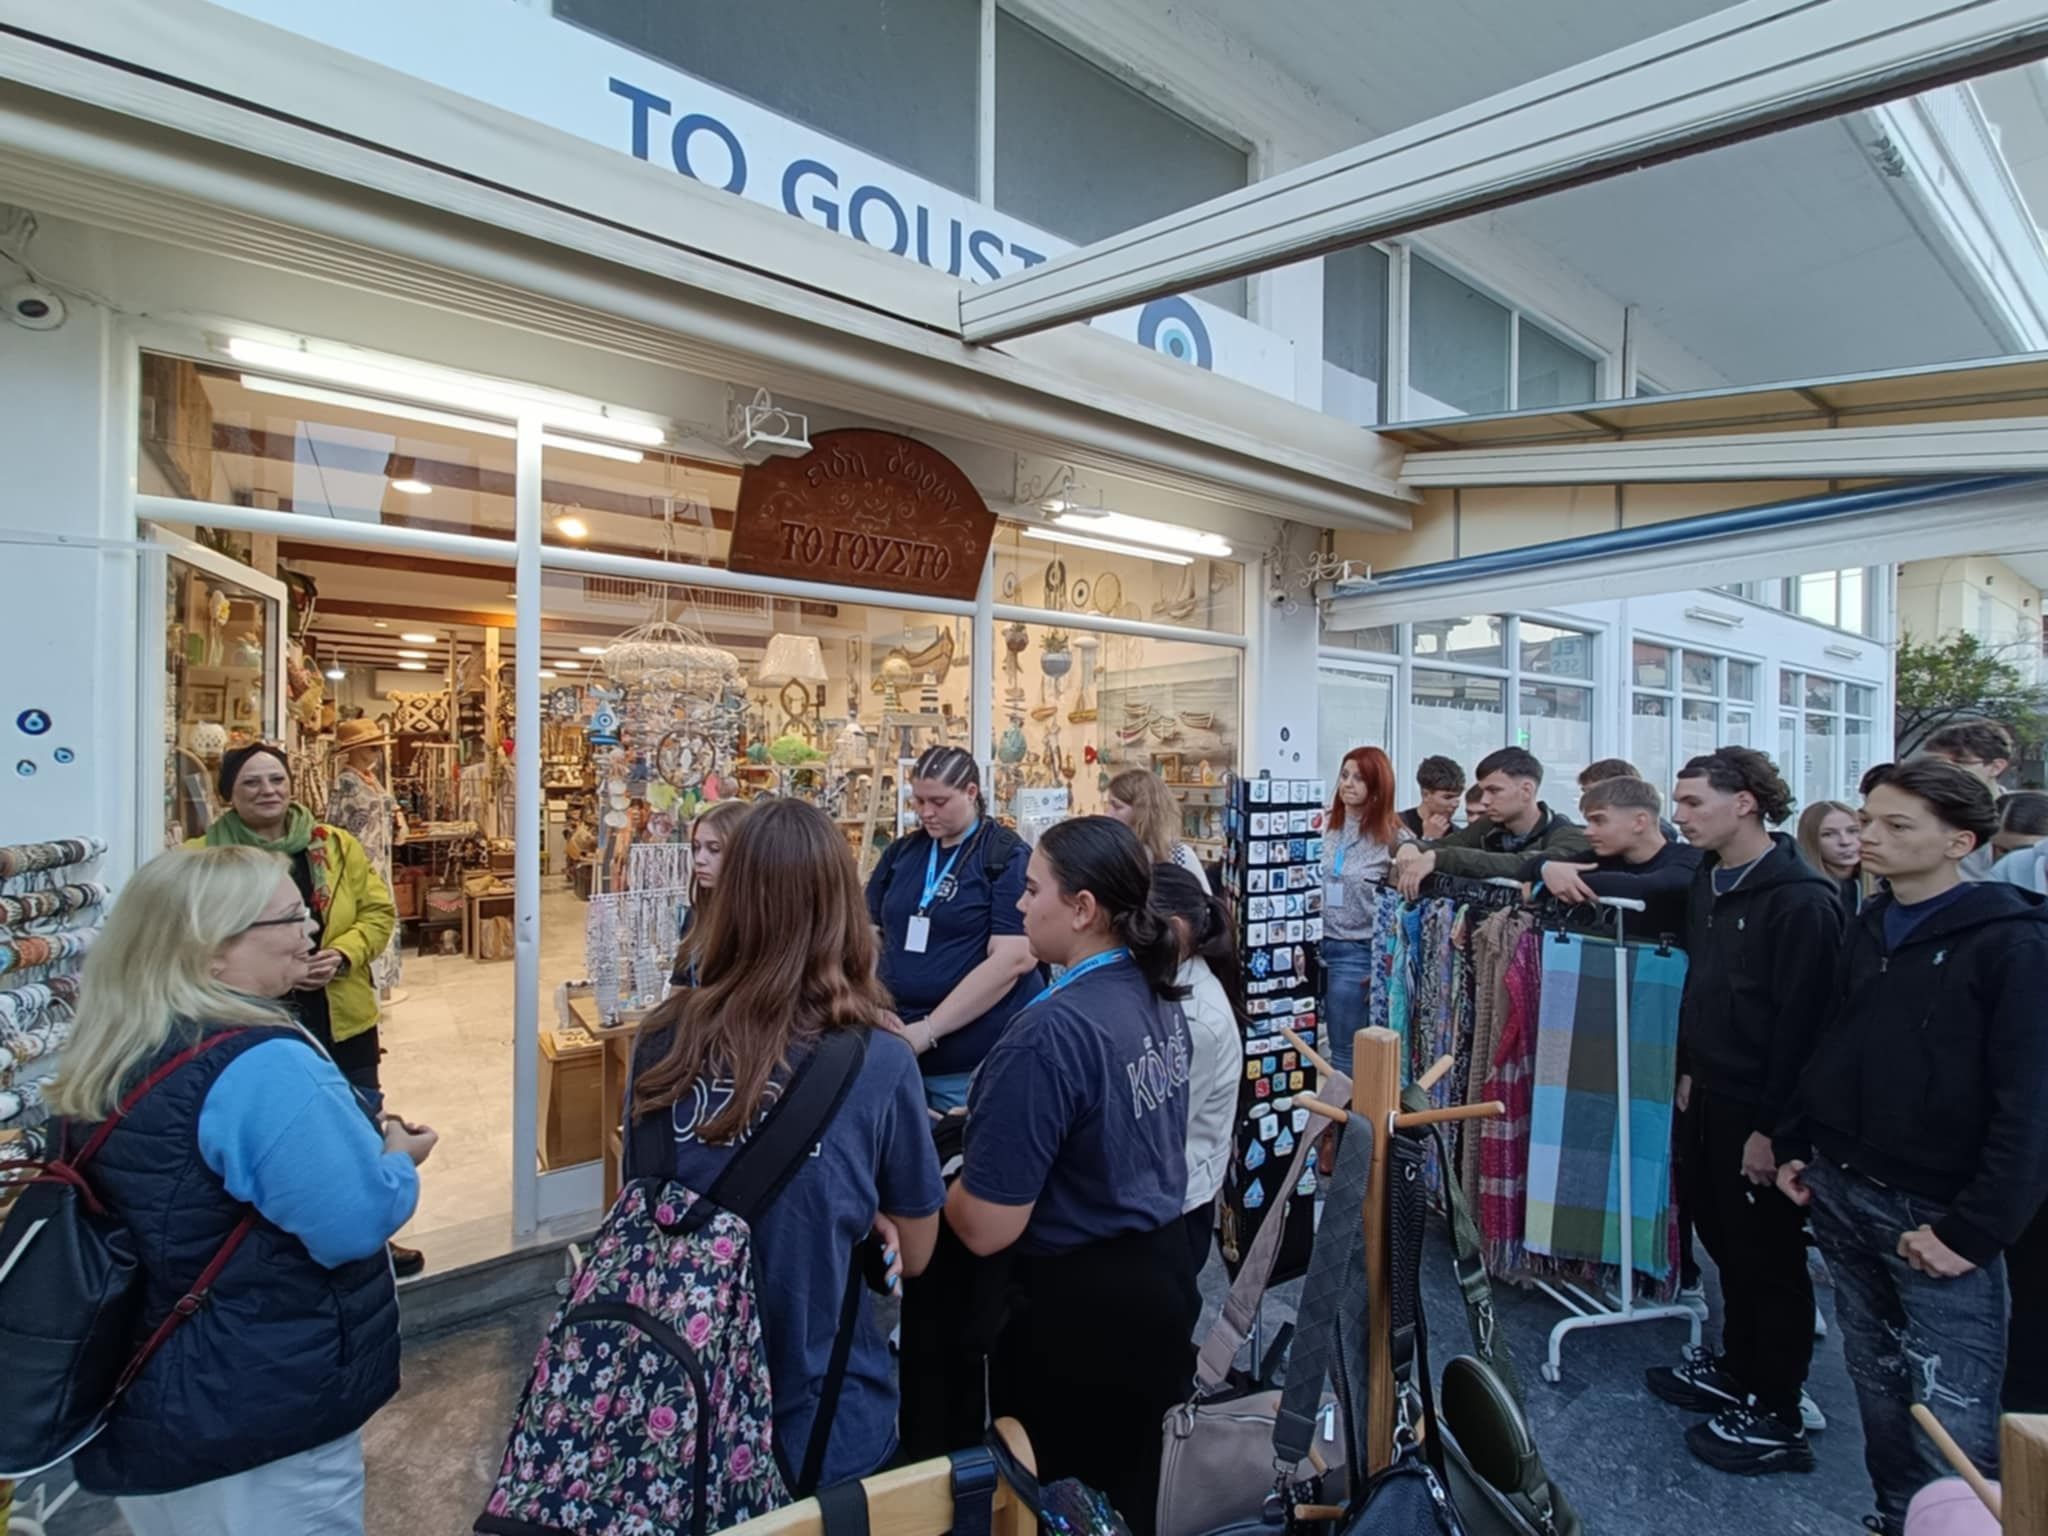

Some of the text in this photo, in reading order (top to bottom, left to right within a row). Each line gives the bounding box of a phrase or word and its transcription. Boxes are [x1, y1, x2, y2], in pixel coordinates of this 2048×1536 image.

[608, 76, 1047, 284] TO GOUST
[828, 529, 952, 580] ΓΟΥΣΤΟ
